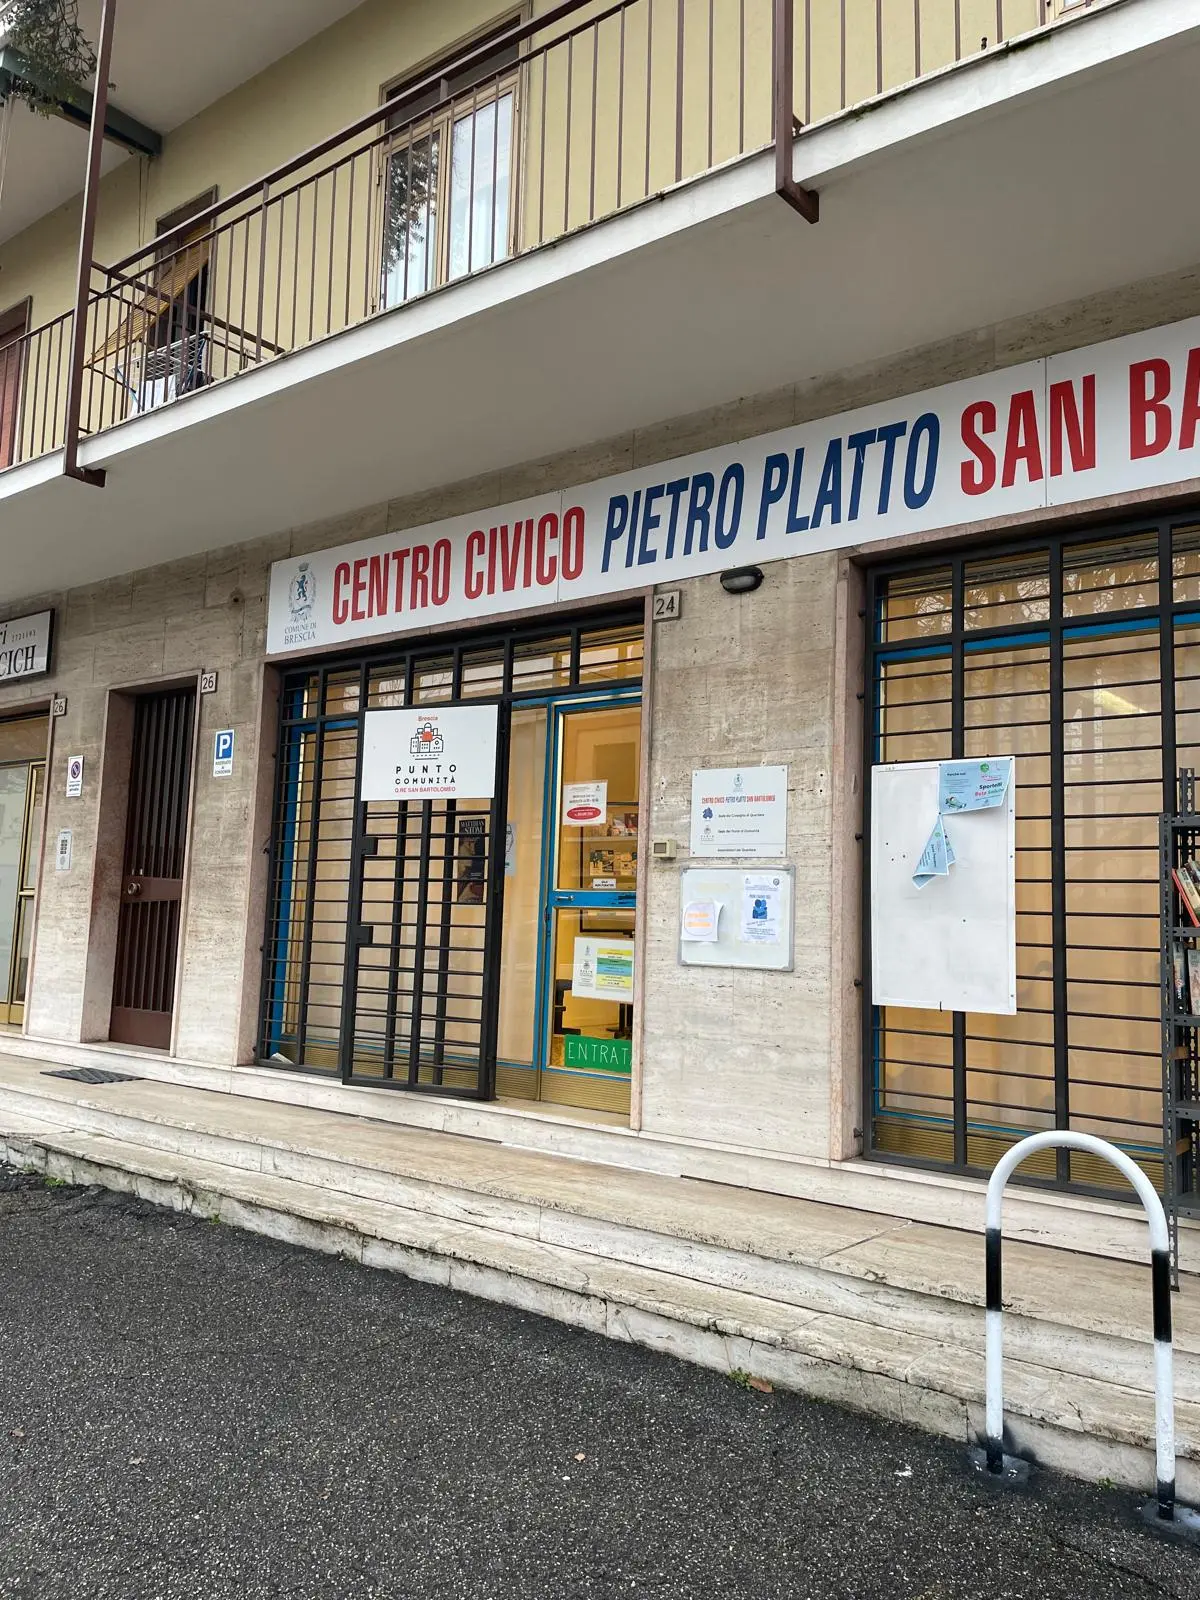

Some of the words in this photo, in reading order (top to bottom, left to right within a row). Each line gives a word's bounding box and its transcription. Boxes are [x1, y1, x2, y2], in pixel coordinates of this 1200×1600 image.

[332, 538, 451, 625] CENTRO
[464, 506, 585, 600] CIVICO
[601, 462, 745, 573] PIETRO
[756, 412, 940, 541] PLATTO
[960, 374, 1096, 495] SAN
[656, 595, 675, 615] 24
[284, 625, 309, 634] COMUNE
[284, 631, 316, 645] BRESCIA
[203, 675, 214, 689] 26
[55, 701, 63, 713] 26
[219, 735, 230, 757] P
[396, 764, 457, 774] PUNTO
[395, 776, 456, 785] COMUNITÀ
